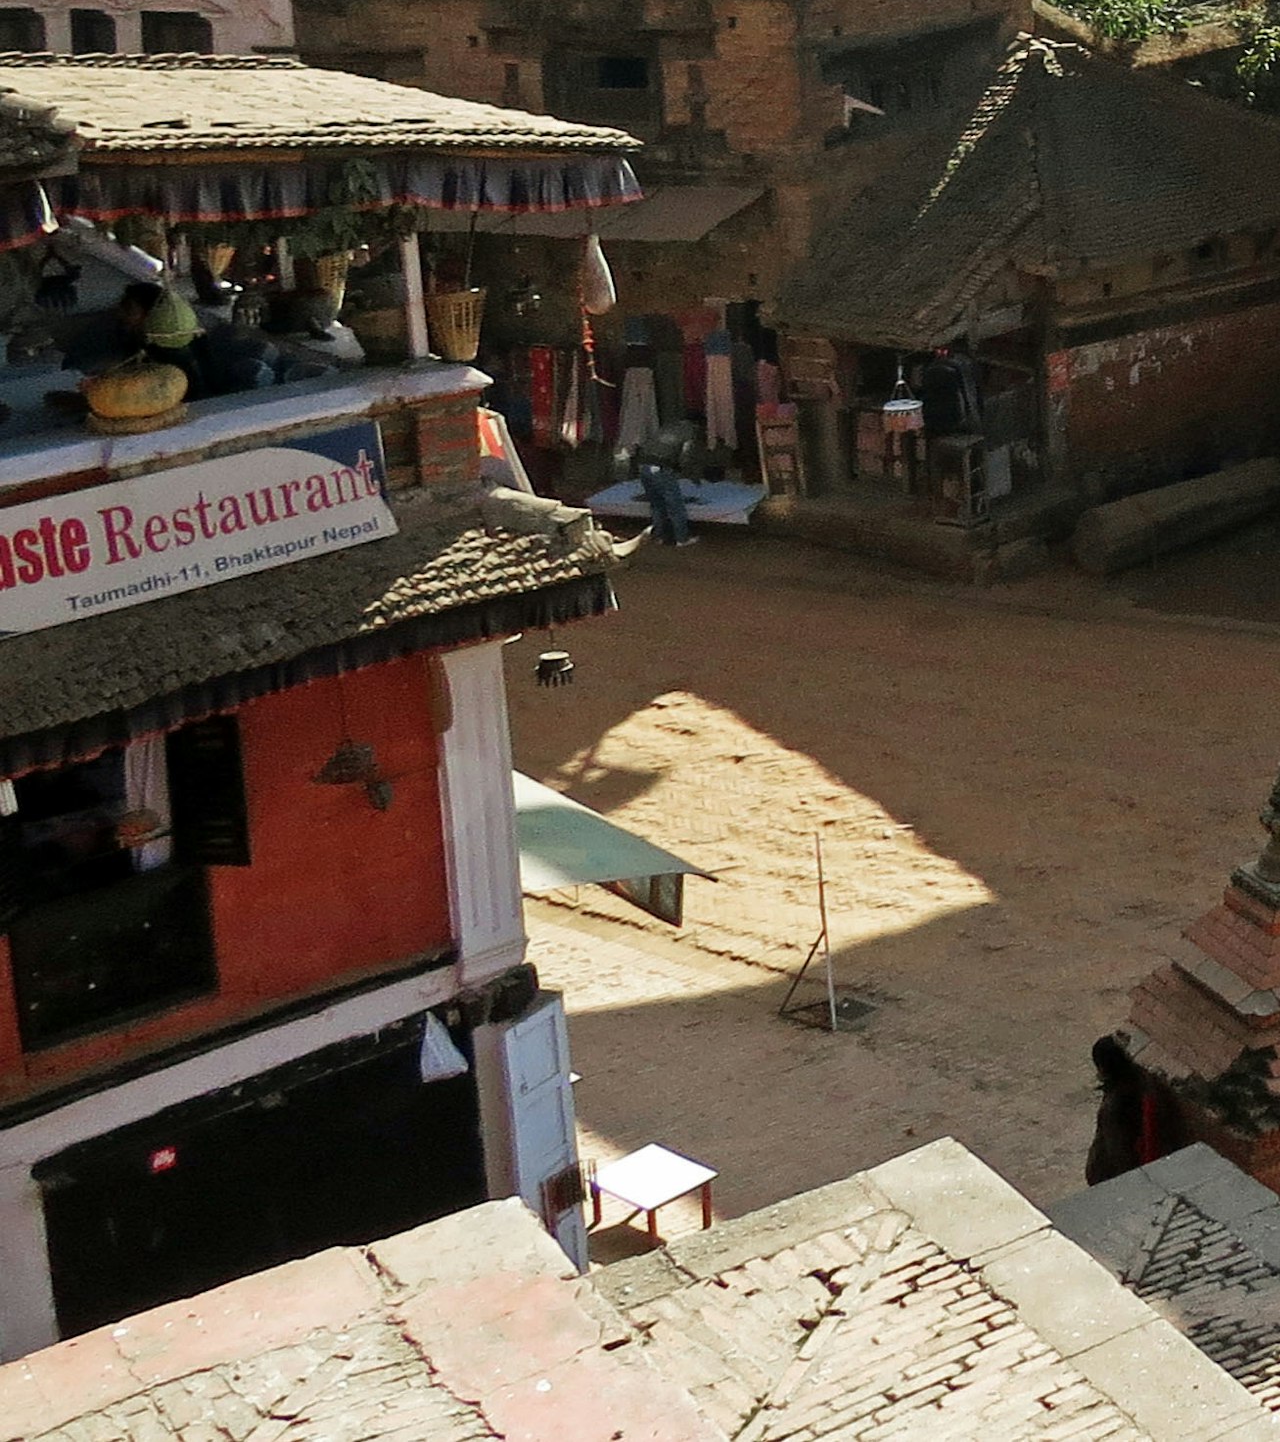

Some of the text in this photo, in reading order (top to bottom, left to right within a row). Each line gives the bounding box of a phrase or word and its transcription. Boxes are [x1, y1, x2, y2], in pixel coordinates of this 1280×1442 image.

[97, 448, 380, 565] Restaurant
[66, 516, 380, 611] Taumadhi-11, Bhaktapur Nepal
